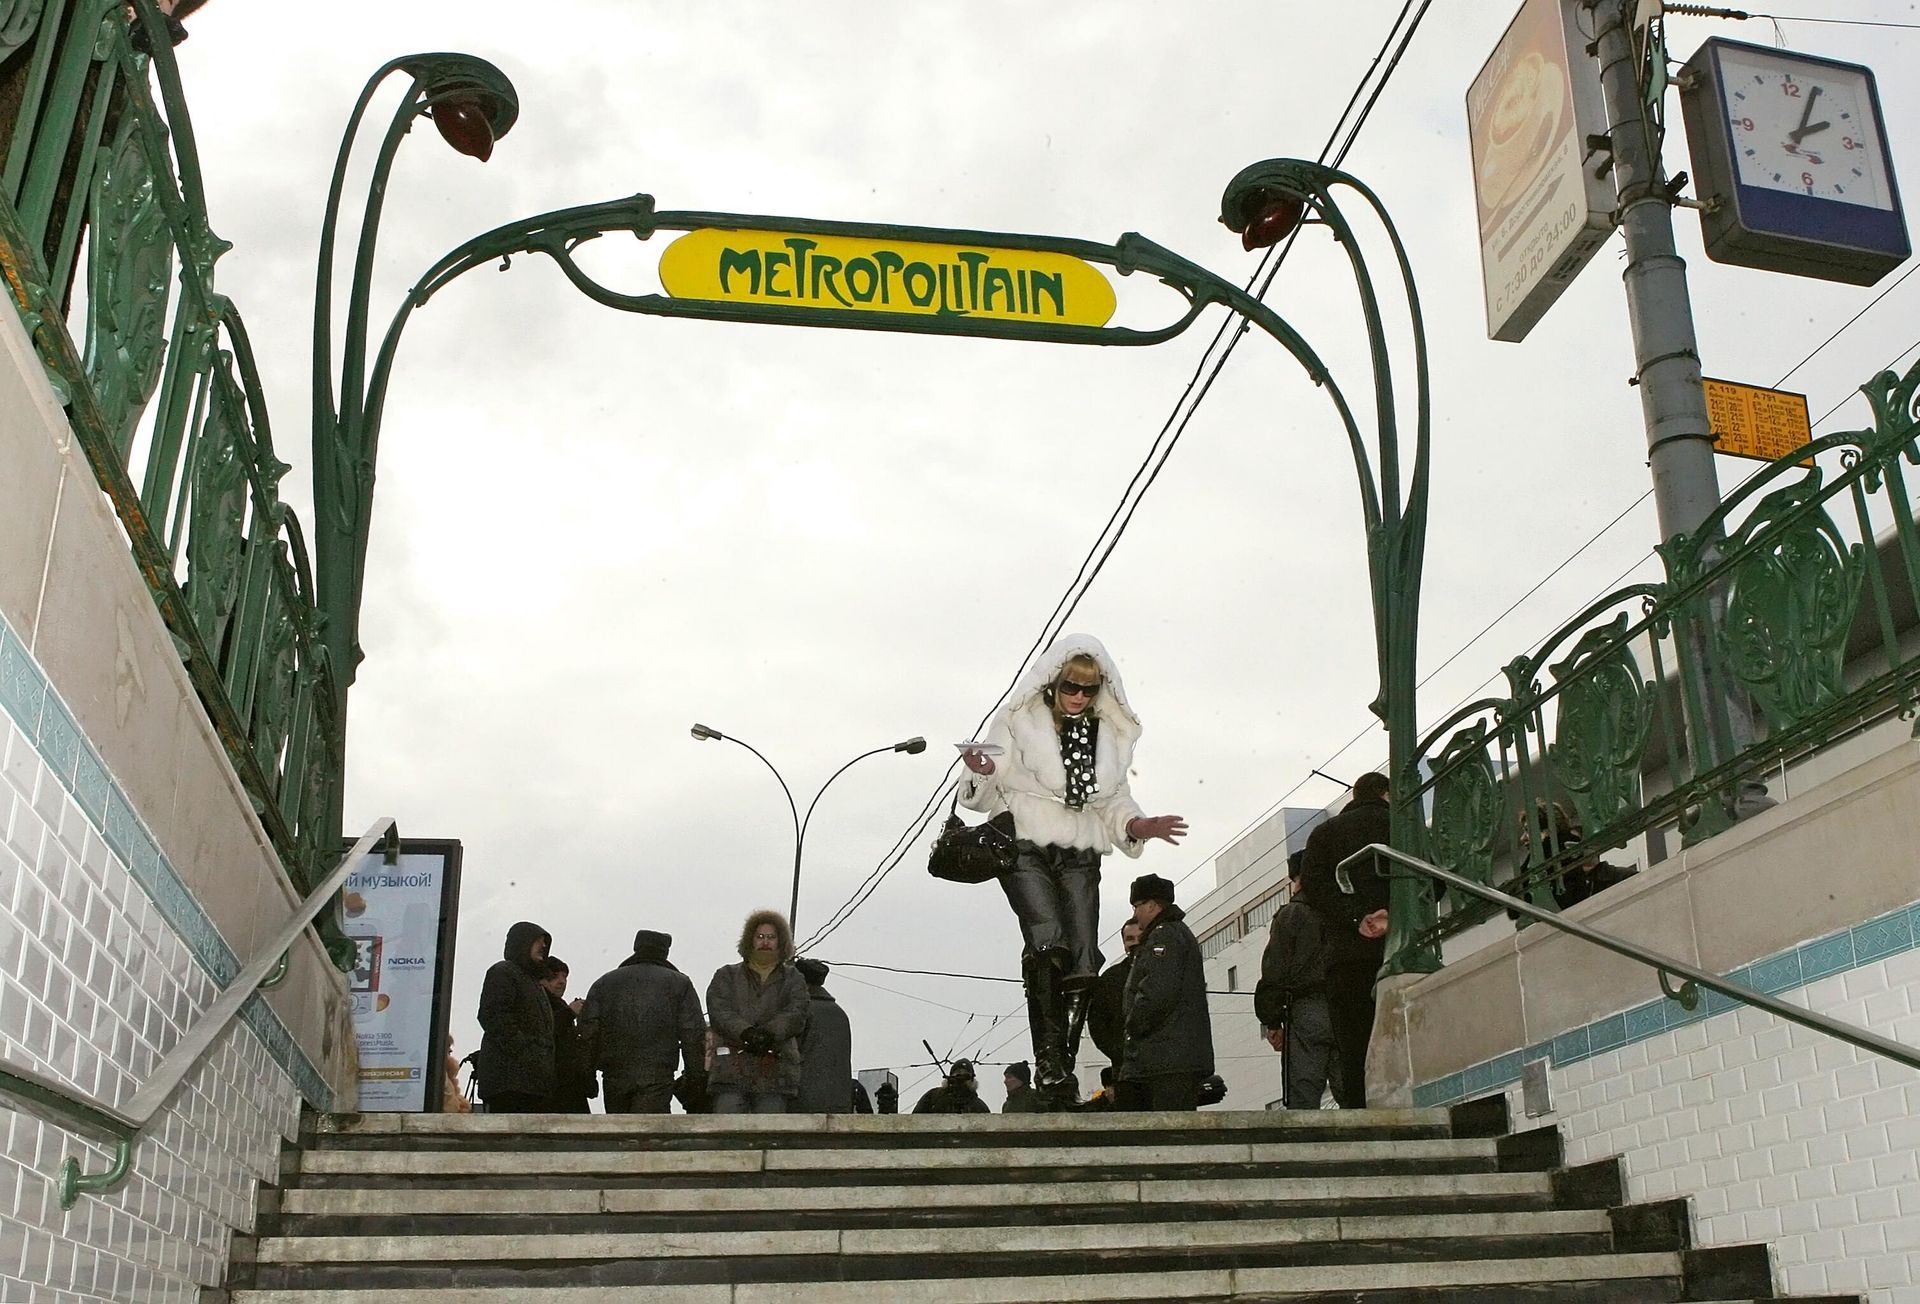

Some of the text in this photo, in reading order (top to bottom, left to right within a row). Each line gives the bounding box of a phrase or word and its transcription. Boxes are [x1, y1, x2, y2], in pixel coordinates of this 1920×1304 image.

[1781, 82, 1801, 98] 12
[1742, 117, 1755, 131] 9
[1842, 136, 1855, 151] 3
[1801, 172, 1814, 186] 6
[1504, 265, 1528, 300] 7:30
[1530, 248, 1544, 276] до
[1546, 203, 1576, 250] 24:00
[719, 238, 1064, 317] METROPOLITAIN
[361, 872, 432, 889] музыкой!
[388, 957, 426, 965] NOKIA
